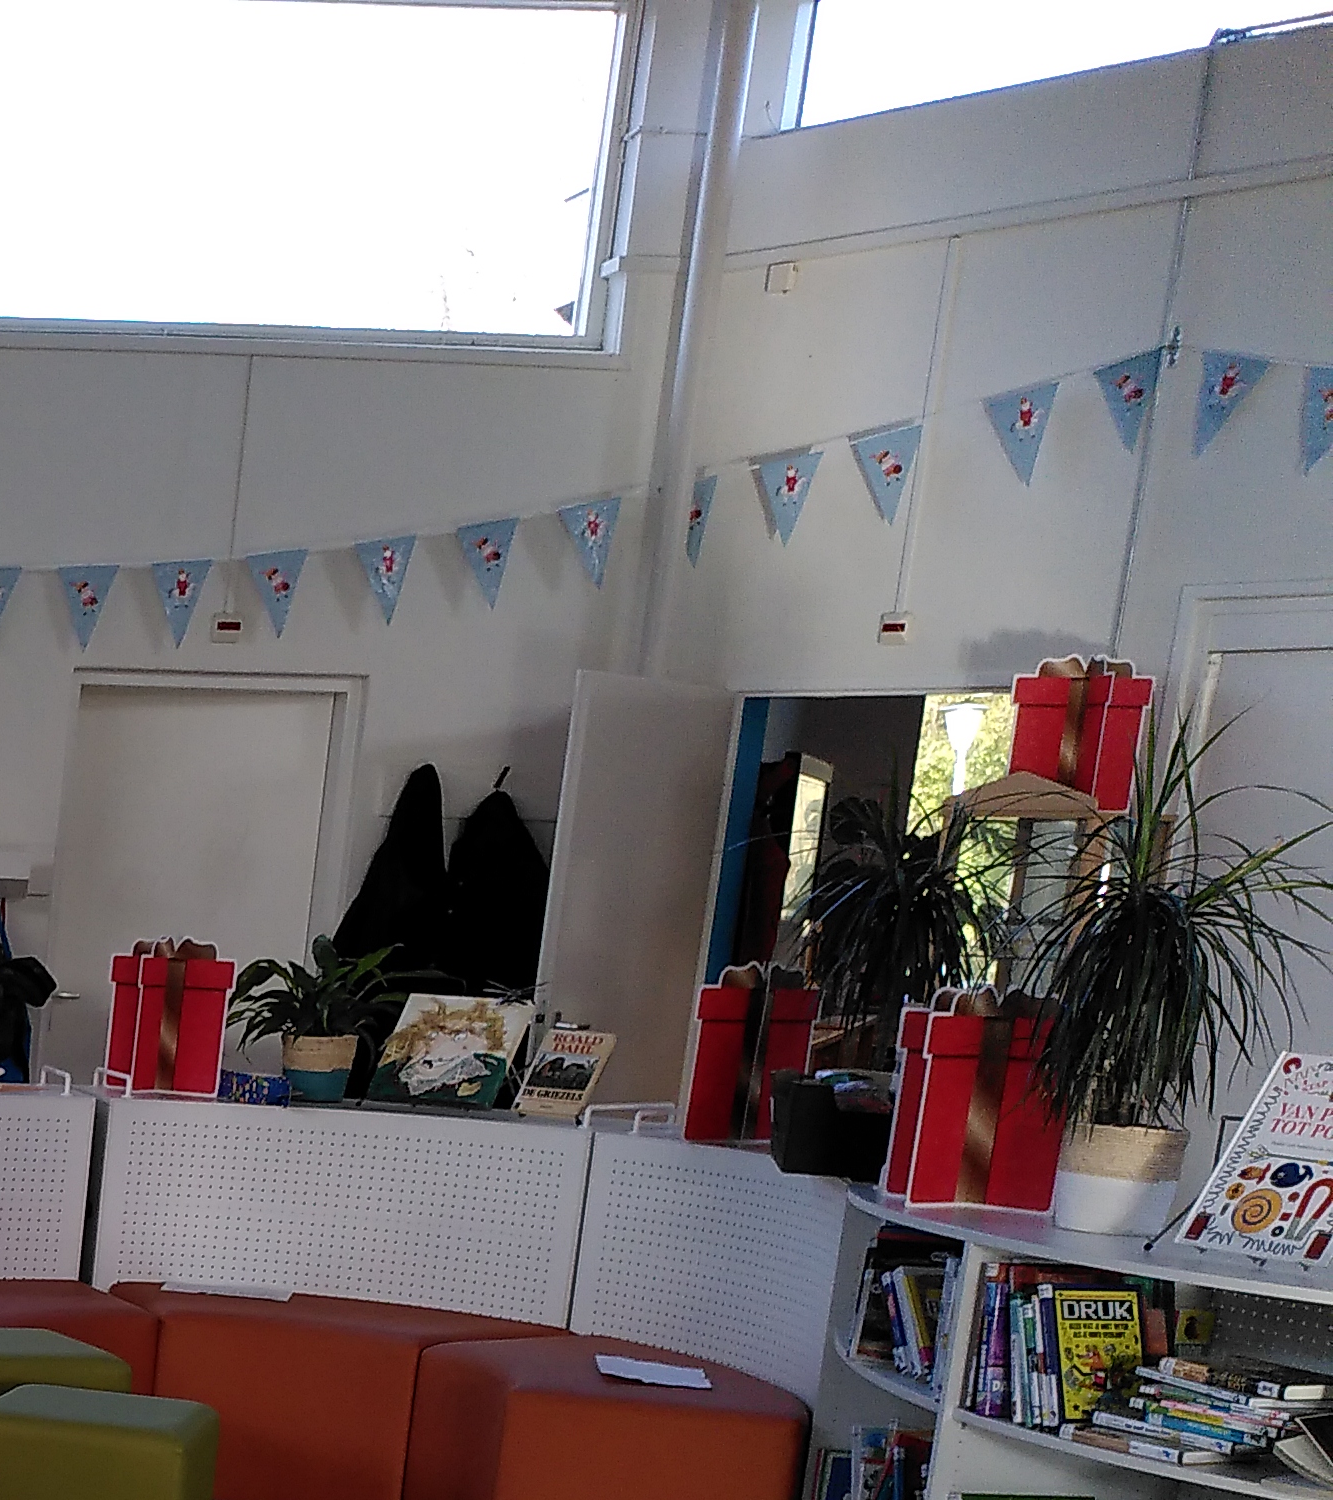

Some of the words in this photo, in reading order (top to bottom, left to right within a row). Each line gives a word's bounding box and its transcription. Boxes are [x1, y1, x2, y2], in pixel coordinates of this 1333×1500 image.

[553, 1033, 604, 1045] ROALD
[553, 1043, 592, 1054] DAHL
[521, 1088, 534, 1097] DE
[536, 1089, 584, 1101] GRIEZELS
[1279, 1102, 1320, 1121] VAN
[1270, 1118, 1312, 1136] TOT
[1062, 1300, 1132, 1320] DRUK
